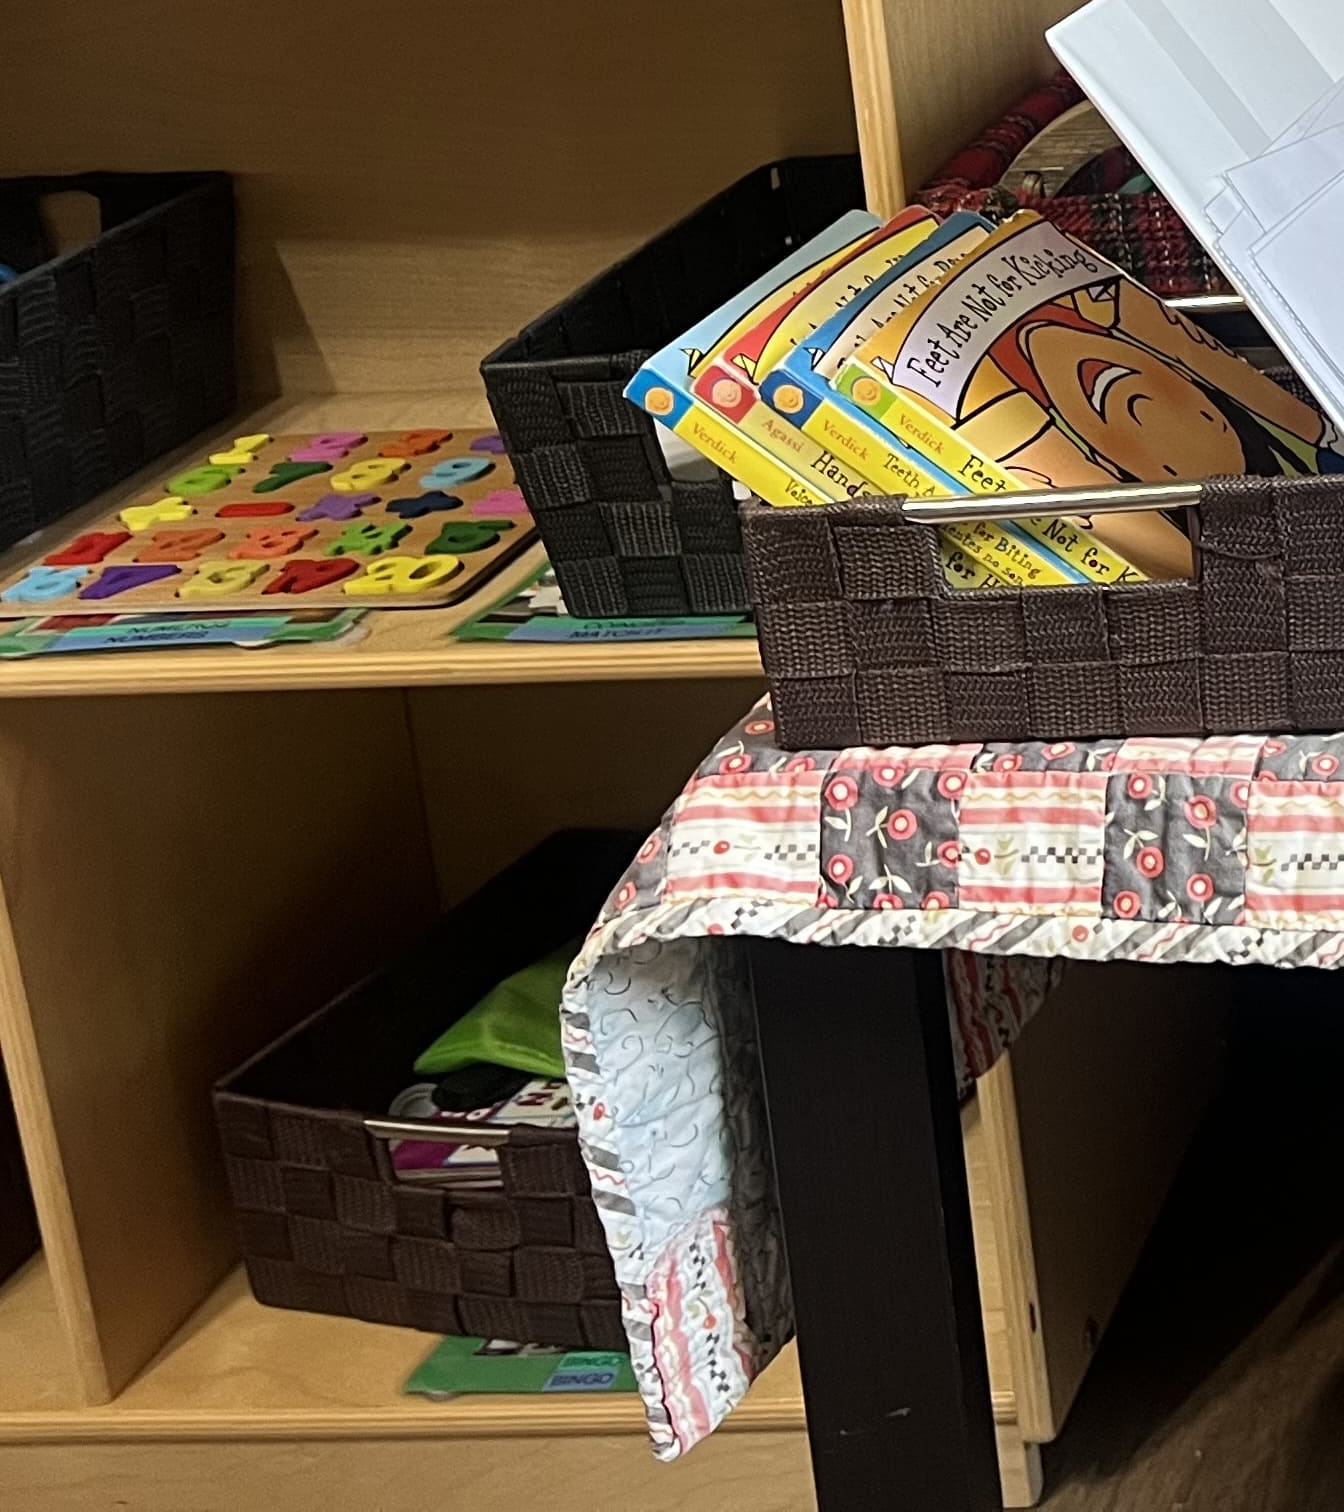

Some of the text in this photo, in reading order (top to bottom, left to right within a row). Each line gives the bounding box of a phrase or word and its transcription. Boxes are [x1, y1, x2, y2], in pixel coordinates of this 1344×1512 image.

[993, 270, 1023, 298] for
[1001, 247, 1099, 286] Kicking
[966, 283, 1007, 323] Not
[937, 313, 979, 351] Are
[906, 338, 960, 388] Feet
[761, 418, 806, 453] Agassi
[823, 419, 920, 489] Verdick Teeth
[898, 413, 1008, 492] Verdick Feet
[692, 423, 814, 507] Verdick Voice
[994, 536, 1042, 580] Biting
[1041, 518, 1078, 553] Not
[1080, 546, 1110, 576] for
[548, 1372, 615, 1387] BINGO
